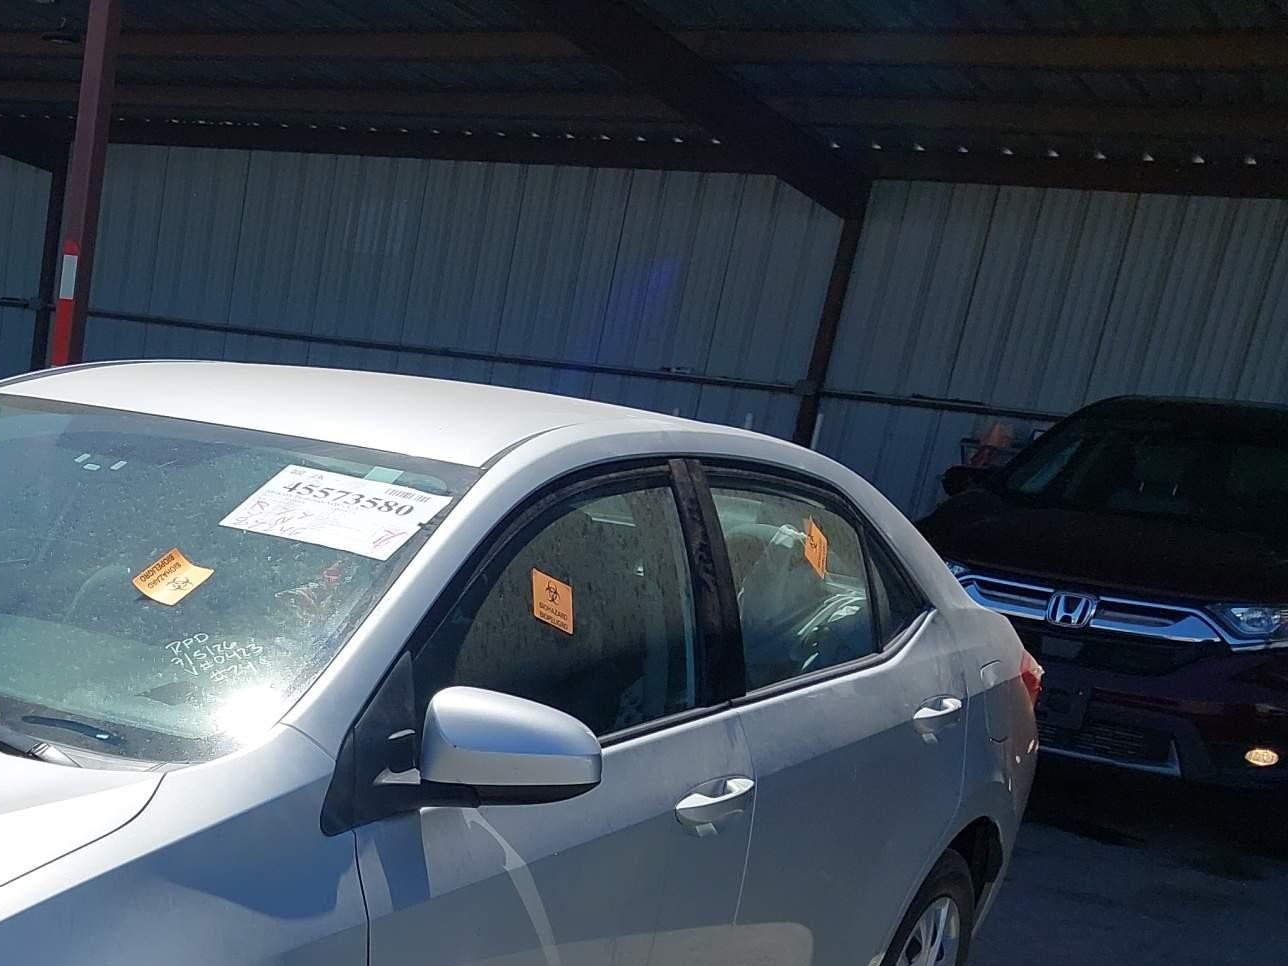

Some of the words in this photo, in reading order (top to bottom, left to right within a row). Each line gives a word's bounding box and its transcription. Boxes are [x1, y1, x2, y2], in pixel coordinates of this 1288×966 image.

[283, 481, 415, 516] 45573580
[139, 553, 175, 582] BIOPELIGRO
[147, 561, 182, 589] BIOHAZARD
